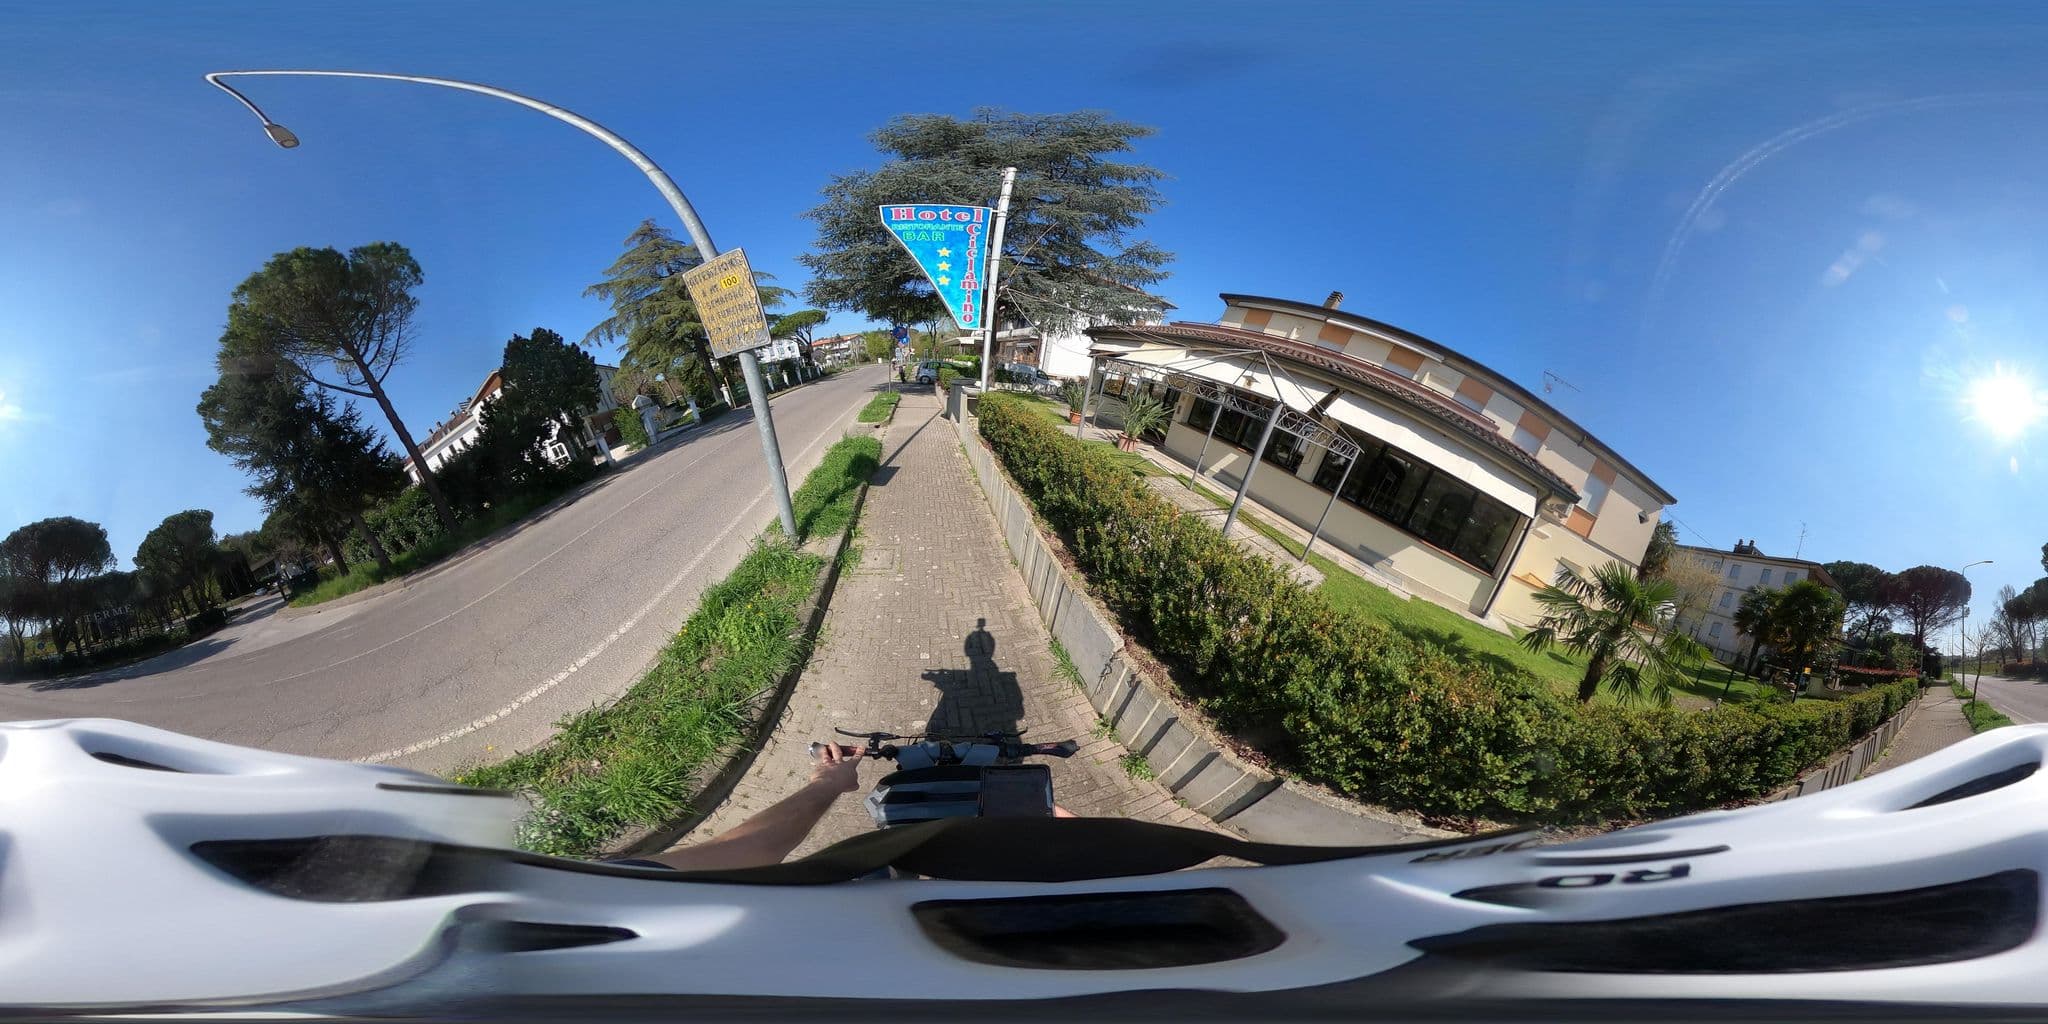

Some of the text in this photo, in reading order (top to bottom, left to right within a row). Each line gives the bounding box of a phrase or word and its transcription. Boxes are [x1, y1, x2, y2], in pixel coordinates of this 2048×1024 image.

[891, 208, 983, 223] Hotel
[891, 223, 965, 231] RISTORANTE
[902, 231, 945, 241] BAR
[961, 223, 982, 322] Ciclamino
[723, 276, 738, 287] 100
